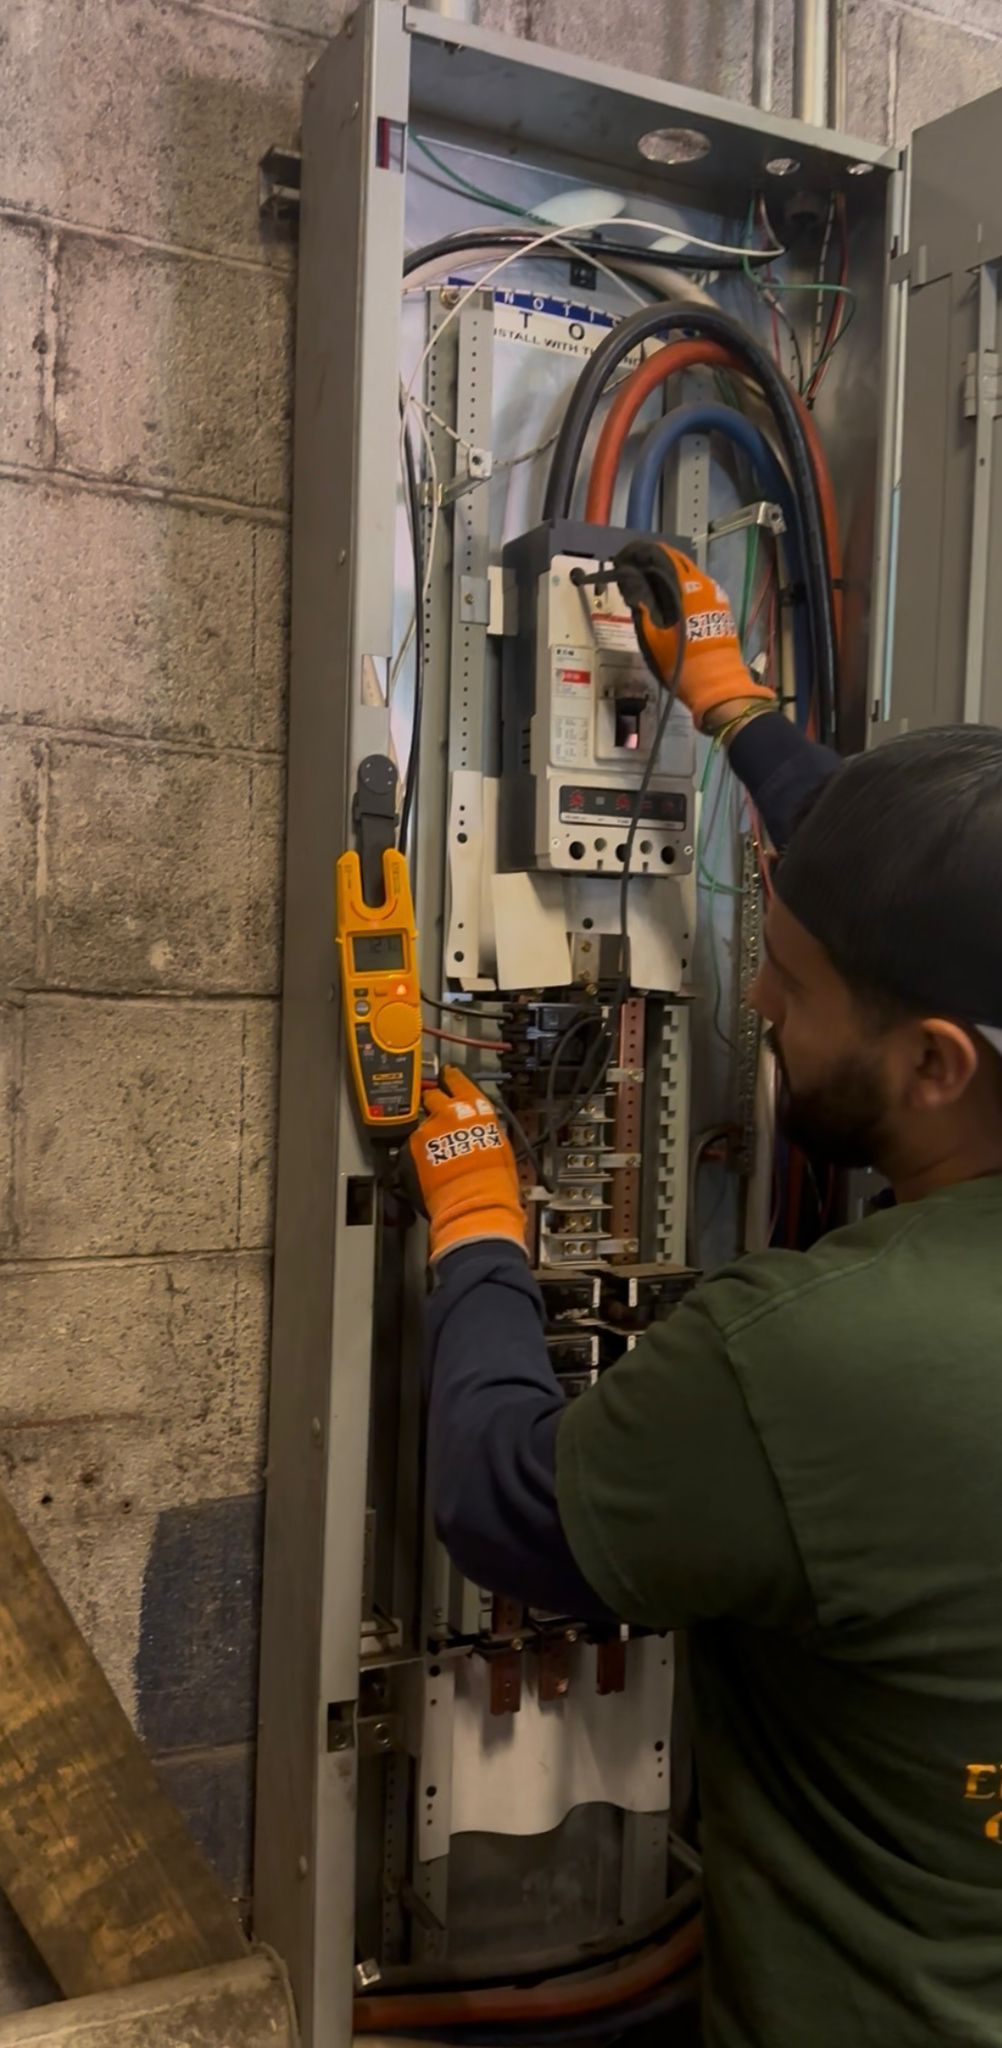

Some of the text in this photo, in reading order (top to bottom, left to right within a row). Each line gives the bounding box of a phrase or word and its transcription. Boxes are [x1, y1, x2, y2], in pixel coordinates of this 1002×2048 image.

[544, 338, 579, 353] WITH
[427, 1123, 498, 1153] TOOLS
[433, 1135, 502, 1165] KLEIN
